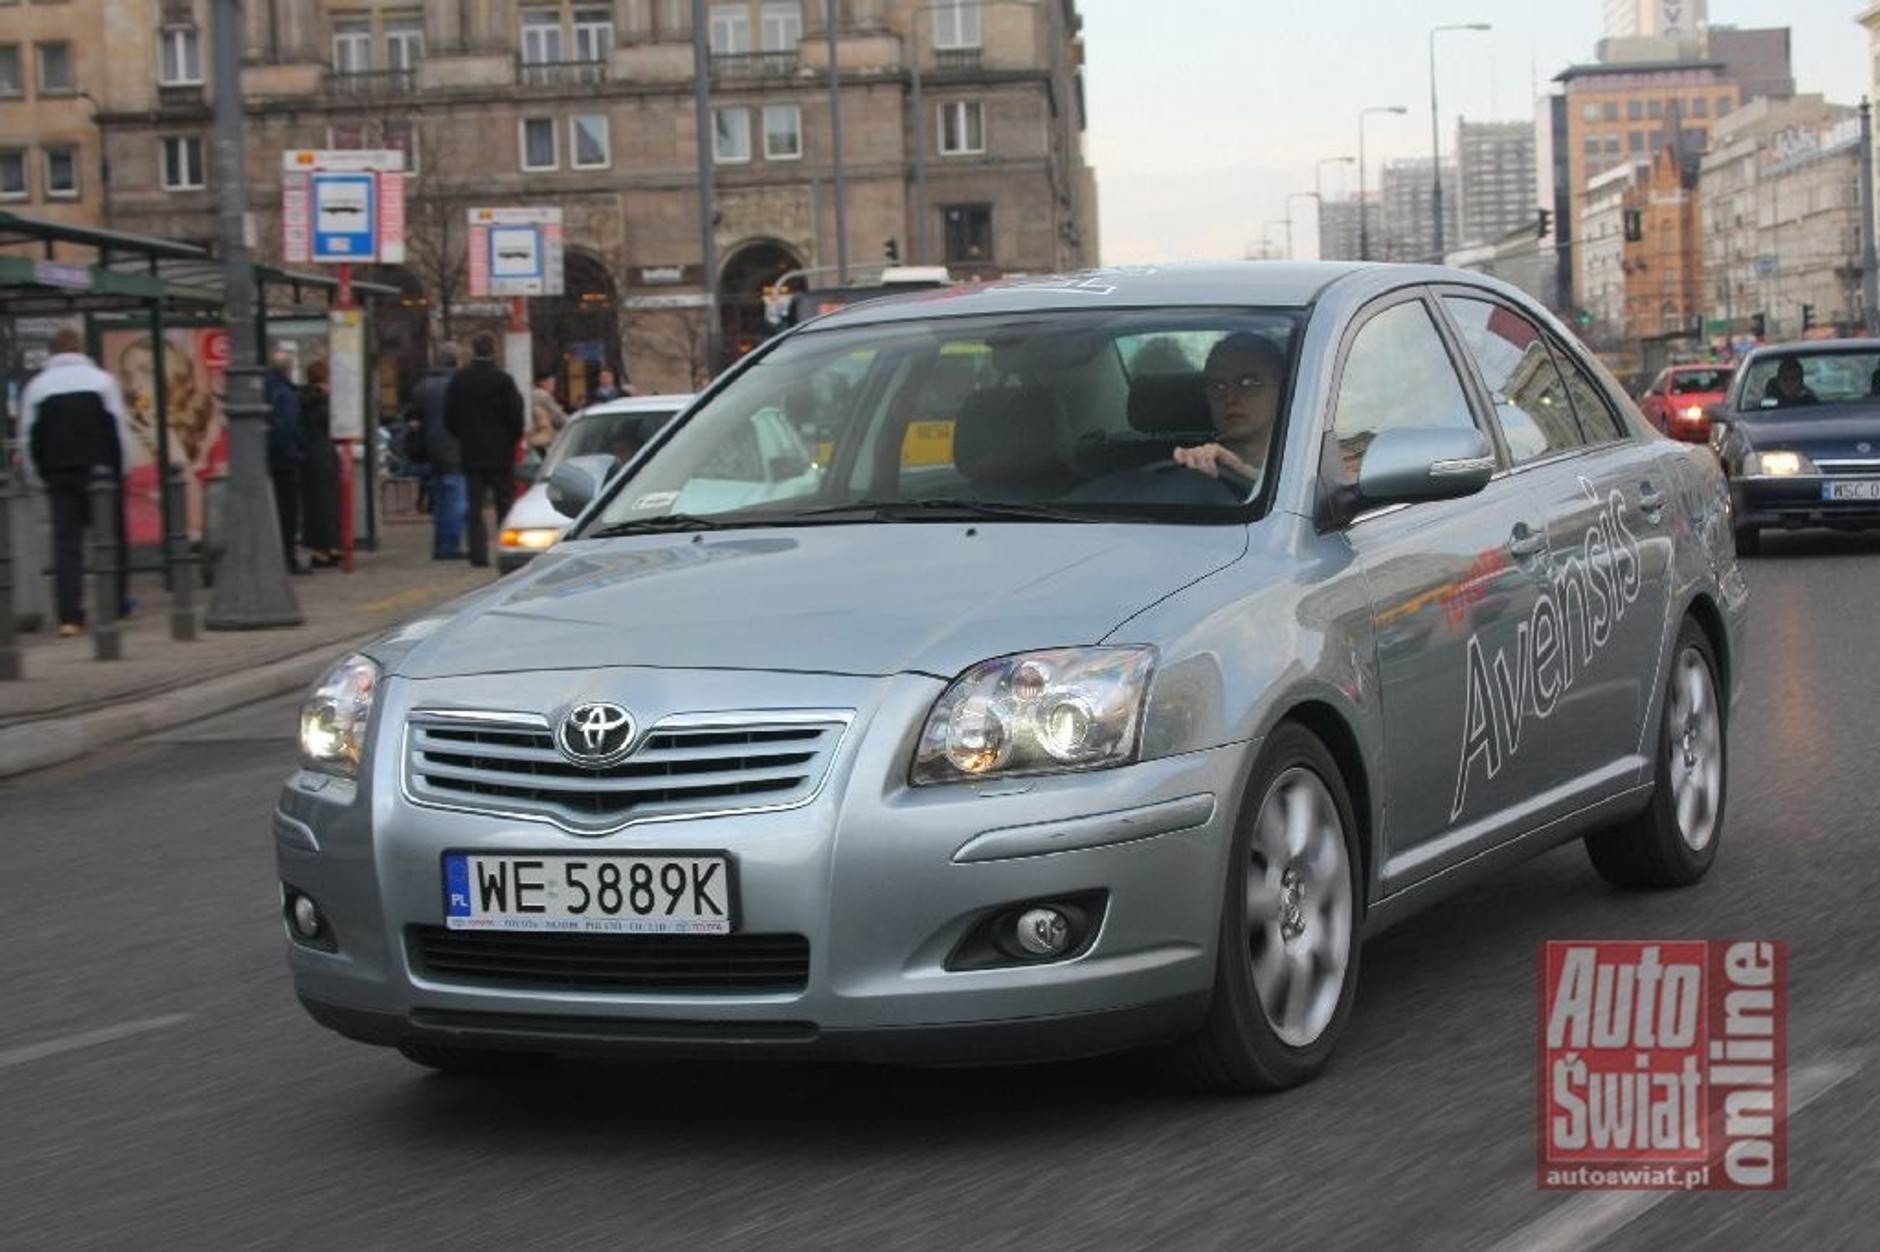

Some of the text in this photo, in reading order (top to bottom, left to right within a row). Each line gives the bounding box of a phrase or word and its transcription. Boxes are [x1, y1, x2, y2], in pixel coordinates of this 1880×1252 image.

[1450, 476, 1641, 823] Avensis
[451, 893, 469, 907] PL
[477, 861, 723, 915] WE 5889K
